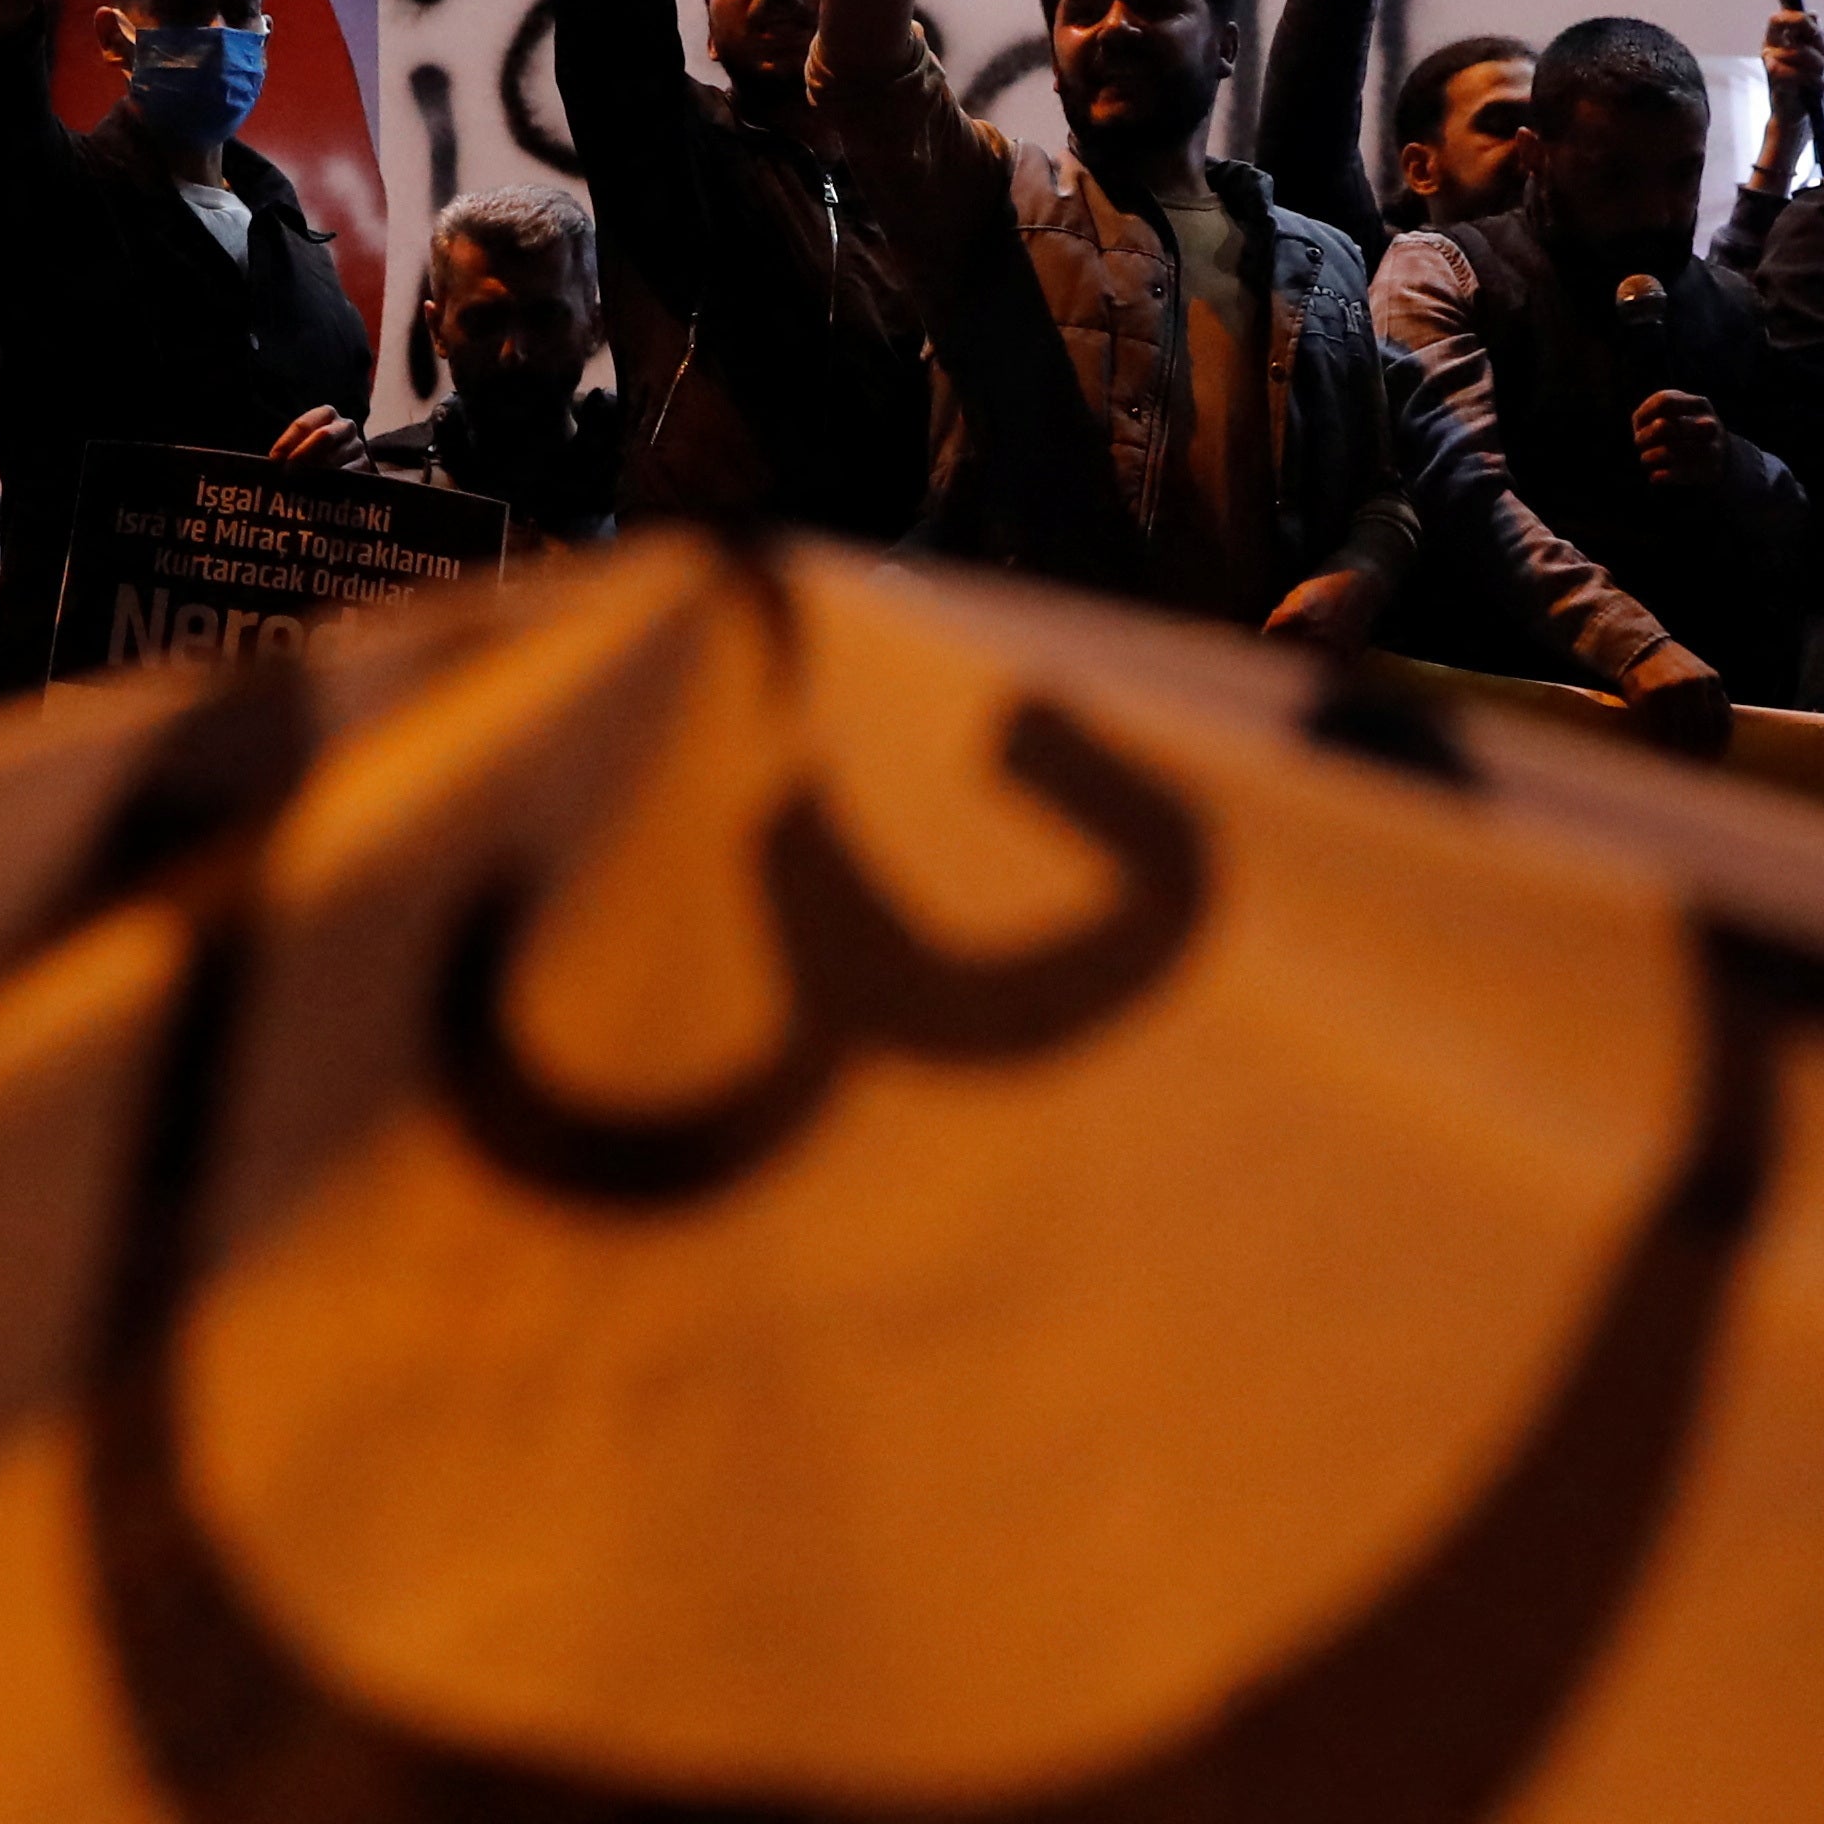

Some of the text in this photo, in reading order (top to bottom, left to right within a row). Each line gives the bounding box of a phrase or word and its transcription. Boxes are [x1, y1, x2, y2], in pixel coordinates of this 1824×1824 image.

[195, 474, 393, 536] İşgal Altındaki
[153, 544, 306, 594] Kurtaracak
[175, 517, 208, 544] ve
[213, 518, 292, 557] Miraç
[296, 529, 463, 581] Topraklarını
